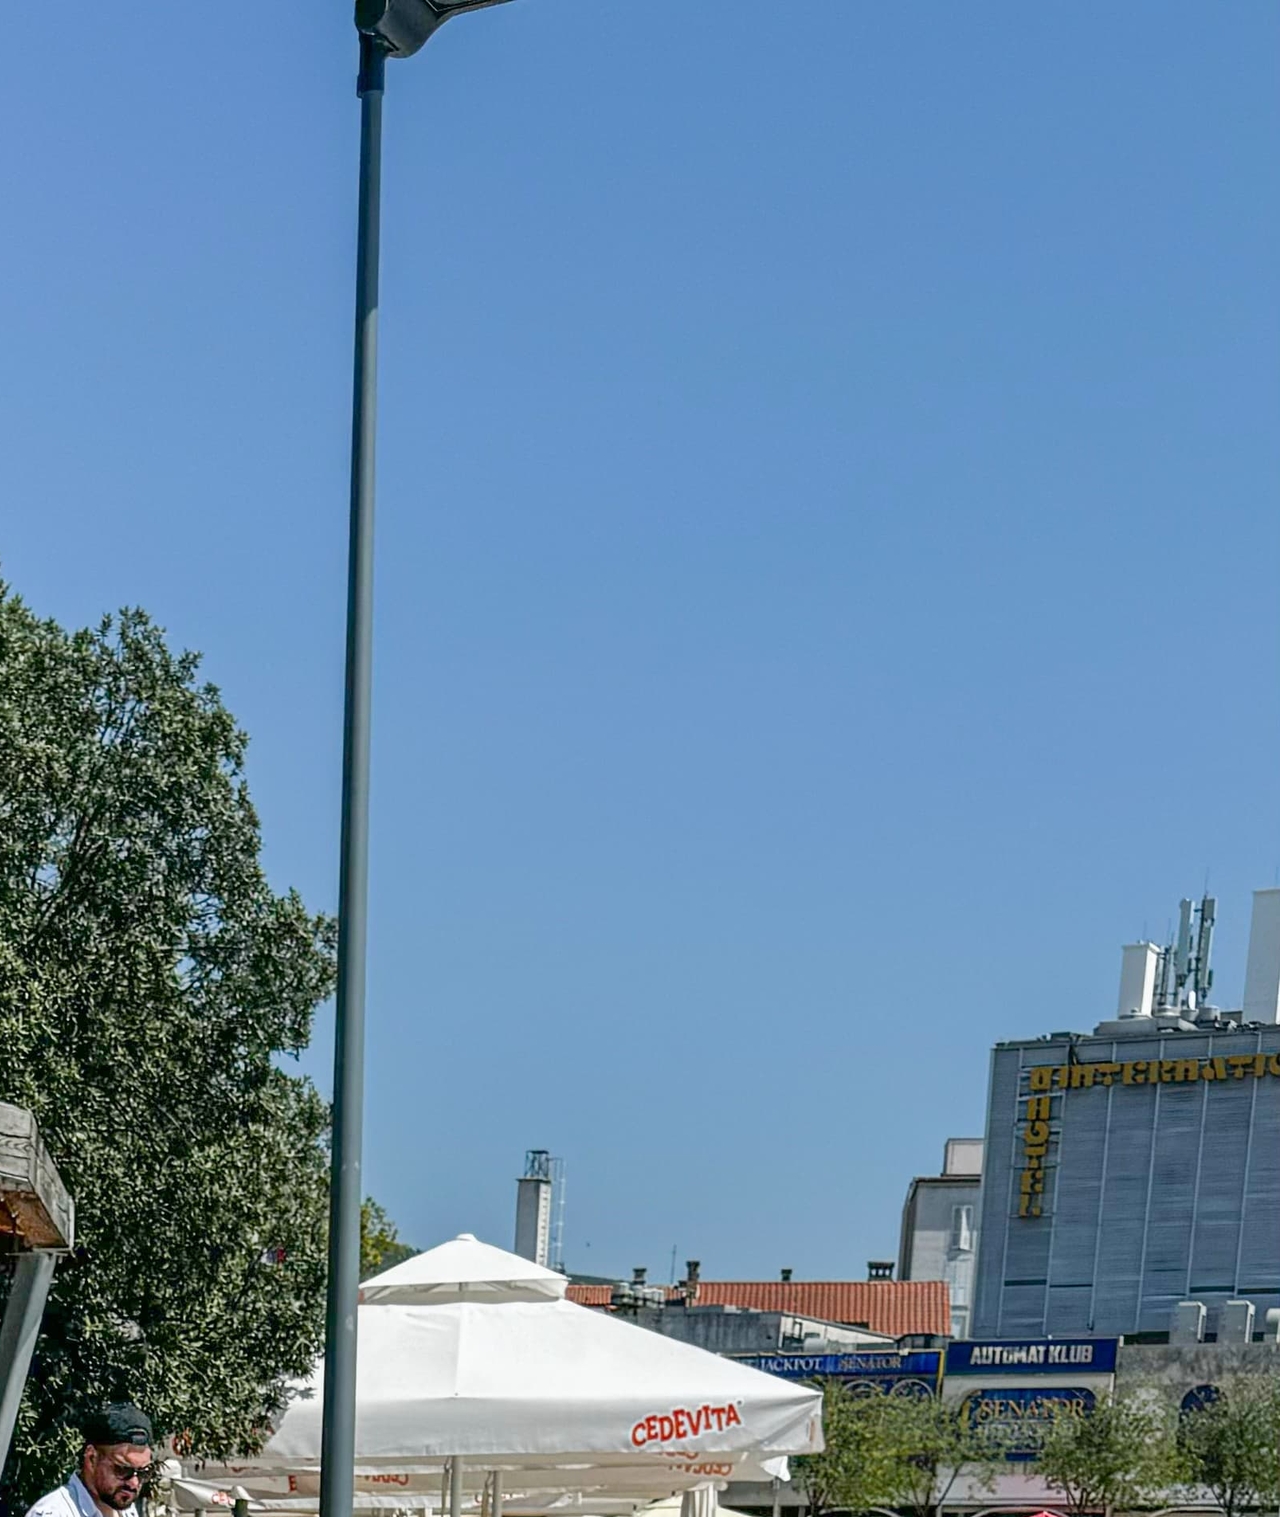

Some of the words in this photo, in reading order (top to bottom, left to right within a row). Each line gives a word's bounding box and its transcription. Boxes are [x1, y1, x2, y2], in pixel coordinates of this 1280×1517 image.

[760, 1358, 823, 1371] JACKPOT
[970, 1345, 1046, 1365] AUTOMAT
[1048, 1345, 1093, 1363] KLUB
[631, 1403, 742, 1447] CEDEVITA
